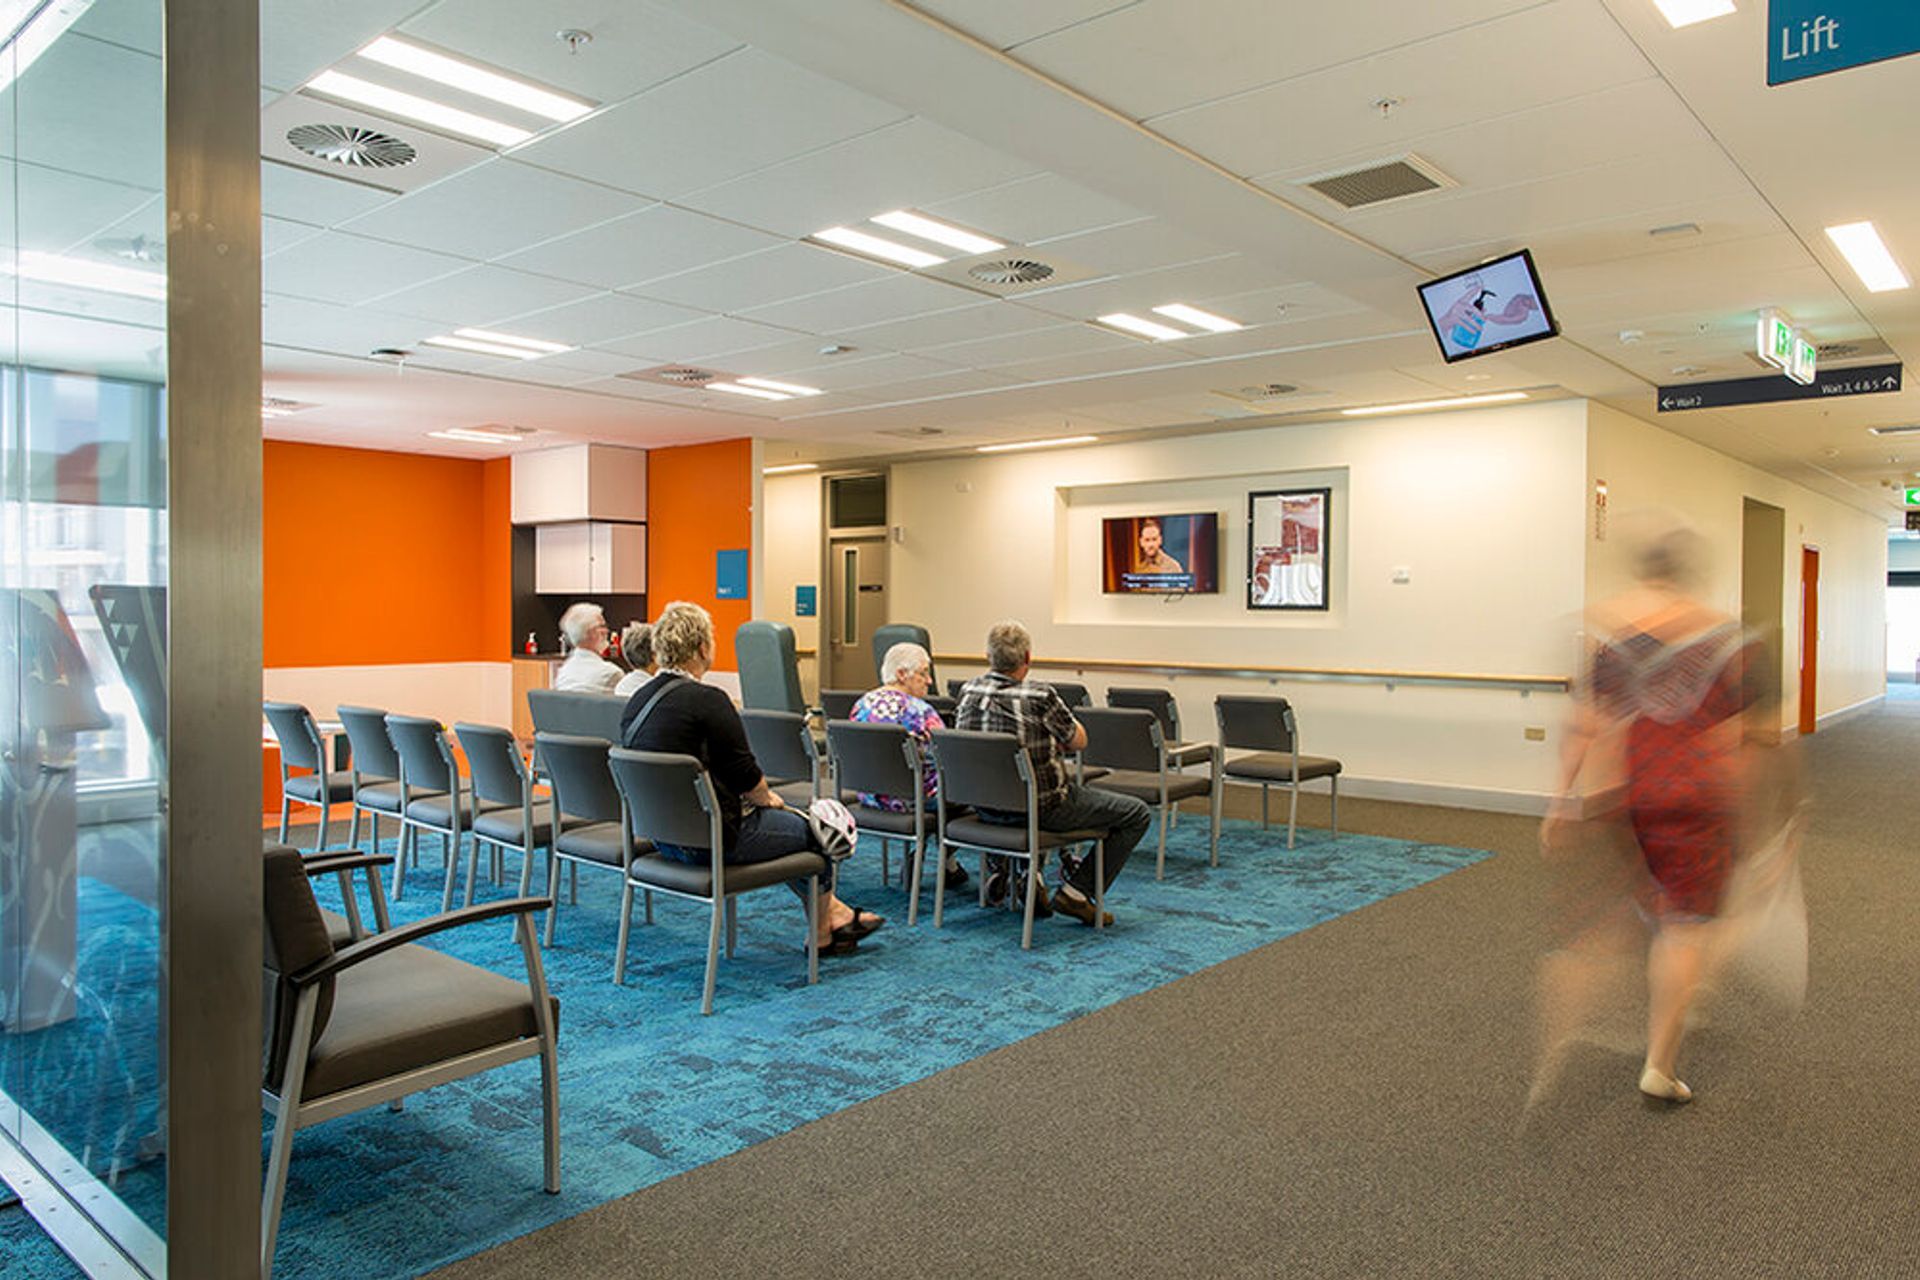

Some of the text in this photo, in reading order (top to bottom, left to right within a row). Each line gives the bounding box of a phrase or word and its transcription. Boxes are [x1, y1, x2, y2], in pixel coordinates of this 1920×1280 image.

[1782, 15, 1840, 60] Lift
[1821, 384, 1842, 395] Wait
[1676, 398, 1696, 407] Wait
